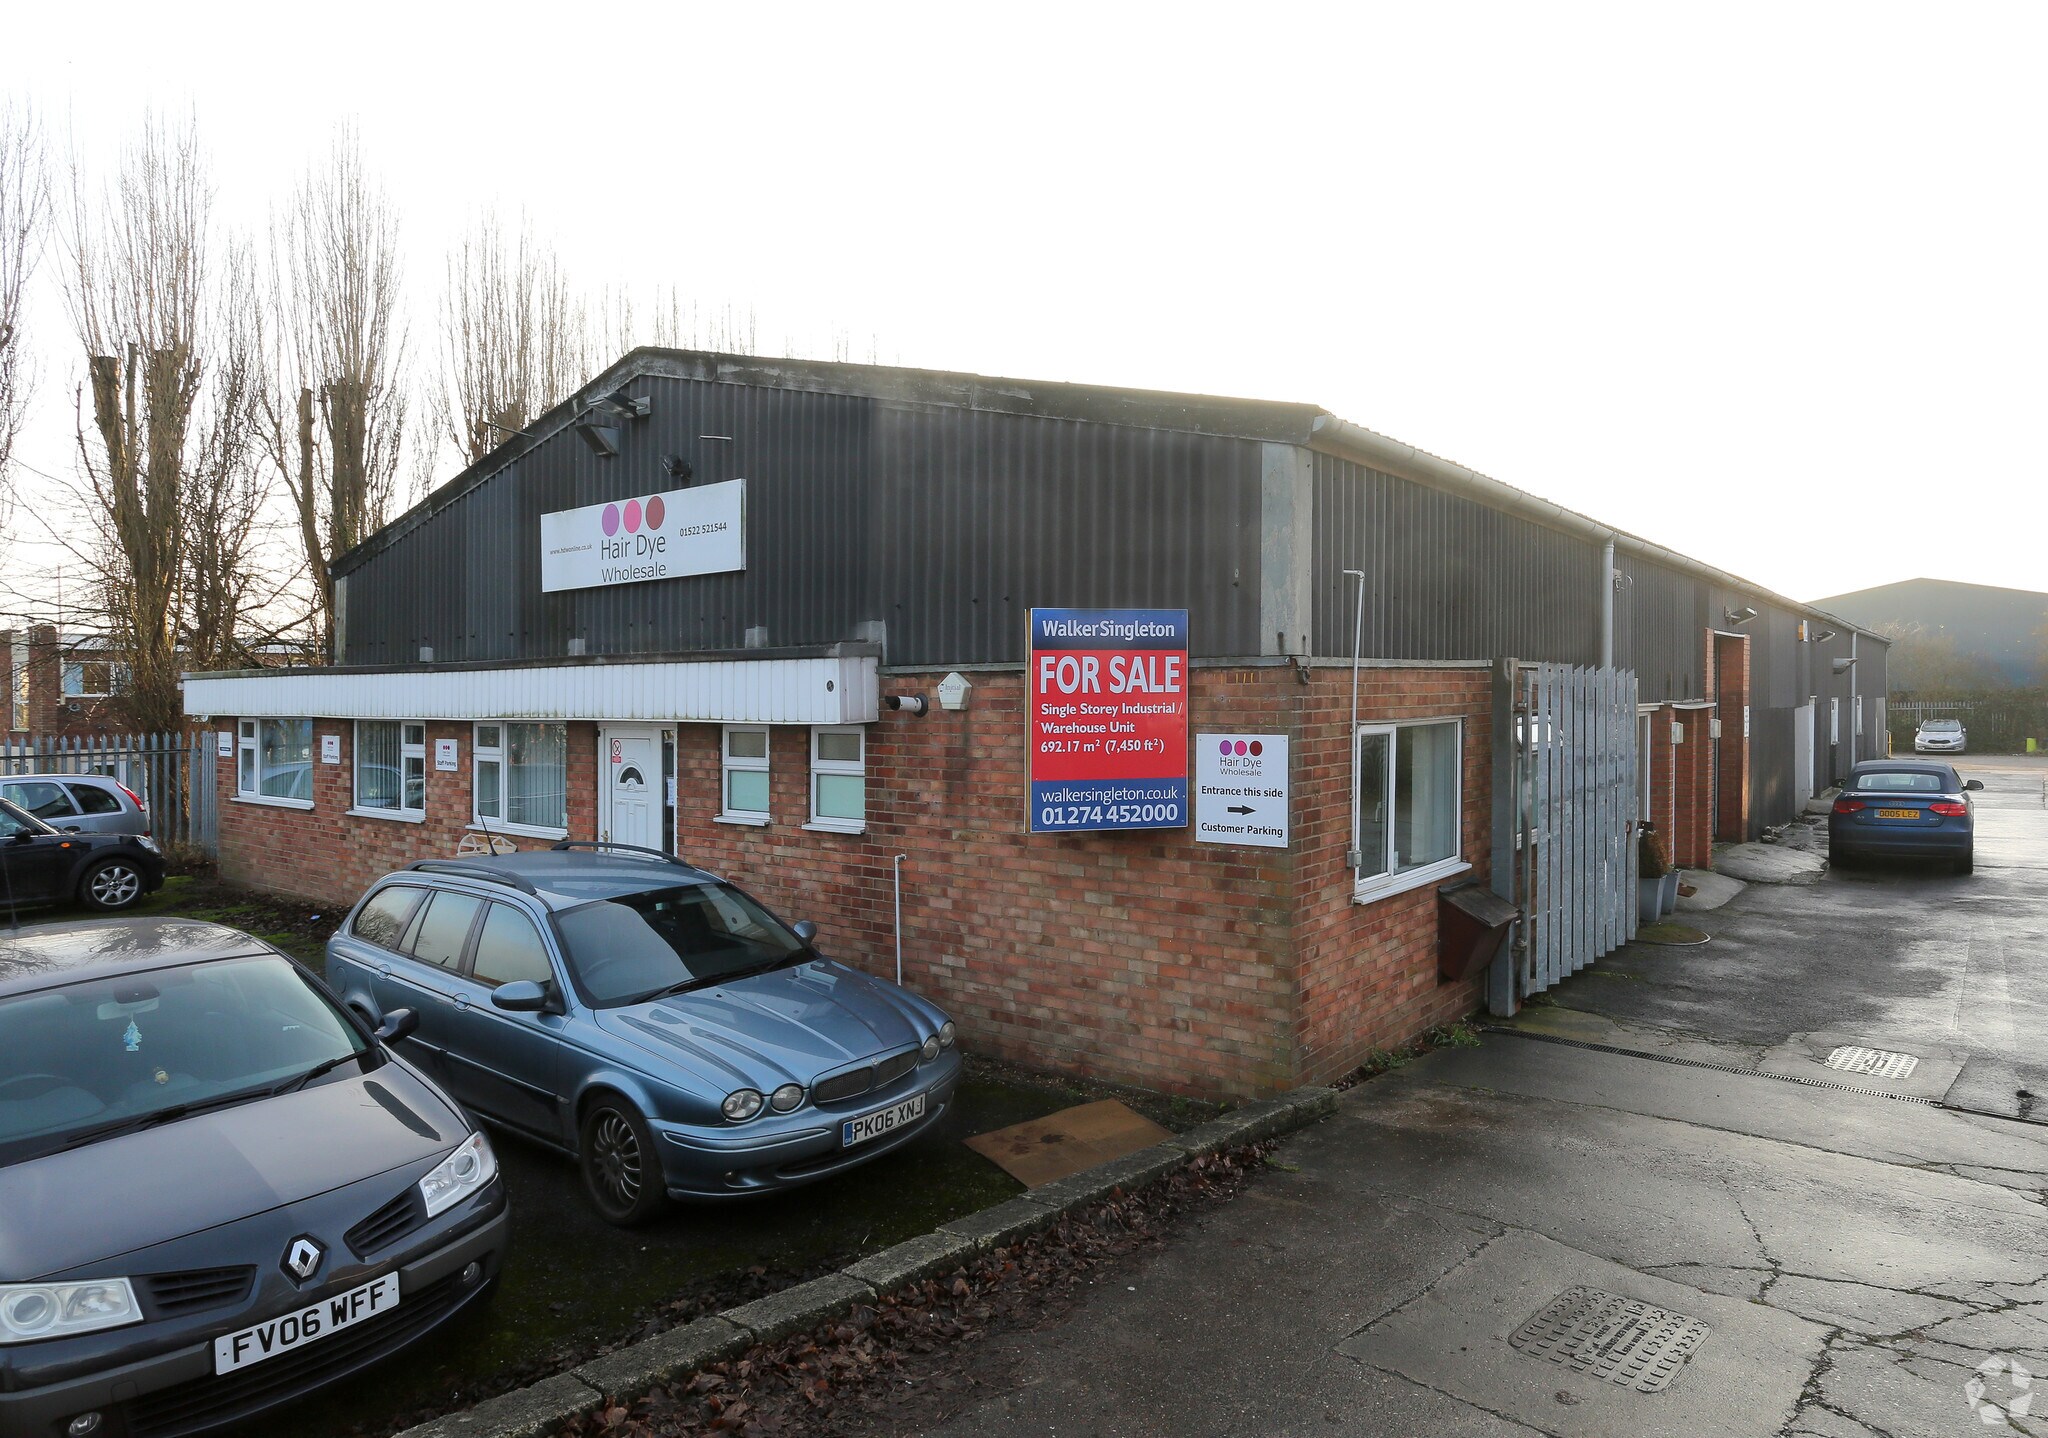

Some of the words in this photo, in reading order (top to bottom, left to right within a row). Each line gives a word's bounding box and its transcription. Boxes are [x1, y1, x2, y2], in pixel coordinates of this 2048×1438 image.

[679, 527, 700, 537] 01522
[702, 521, 728, 534] 521544
[601, 536, 631, 560] Hair
[636, 534, 666, 560] Dye
[601, 562, 667, 583] Wholesale
[1040, 655, 1101, 694] FOR
[1109, 655, 1180, 694] SALE
[1041, 703, 1077, 718] Single
[1079, 702, 1118, 718] Storey
[1121, 702, 1176, 715] Industrial
[1040, 722, 1107, 734] Warehouse
[1109, 721, 1136, 733] Unit
[1040, 741, 1080, 753] 692.17
[1105, 739, 1141, 755] (7,450
[1219, 757, 1240, 767] Hair
[1242, 757, 1262, 770] Dye
[1219, 768, 1262, 777] Wholesale
[1041, 786, 1178, 805] walkersingleton.co.uk
[1201, 785, 1242, 796] Entrance
[1243, 787, 1262, 797] this
[1263, 788, 1284, 798] side
[1041, 805, 1103, 825] 01274
[1106, 803, 1178, 823] 452000
[1201, 822, 1245, 834] Customer
[1247, 825, 1284, 838] Parking
[853, 1110, 893, 1140] PK06
[898, 1097, 923, 1124] XNJ
[232, 1308, 320, 1364] FV06
[330, 1280, 386, 1327] WFF
